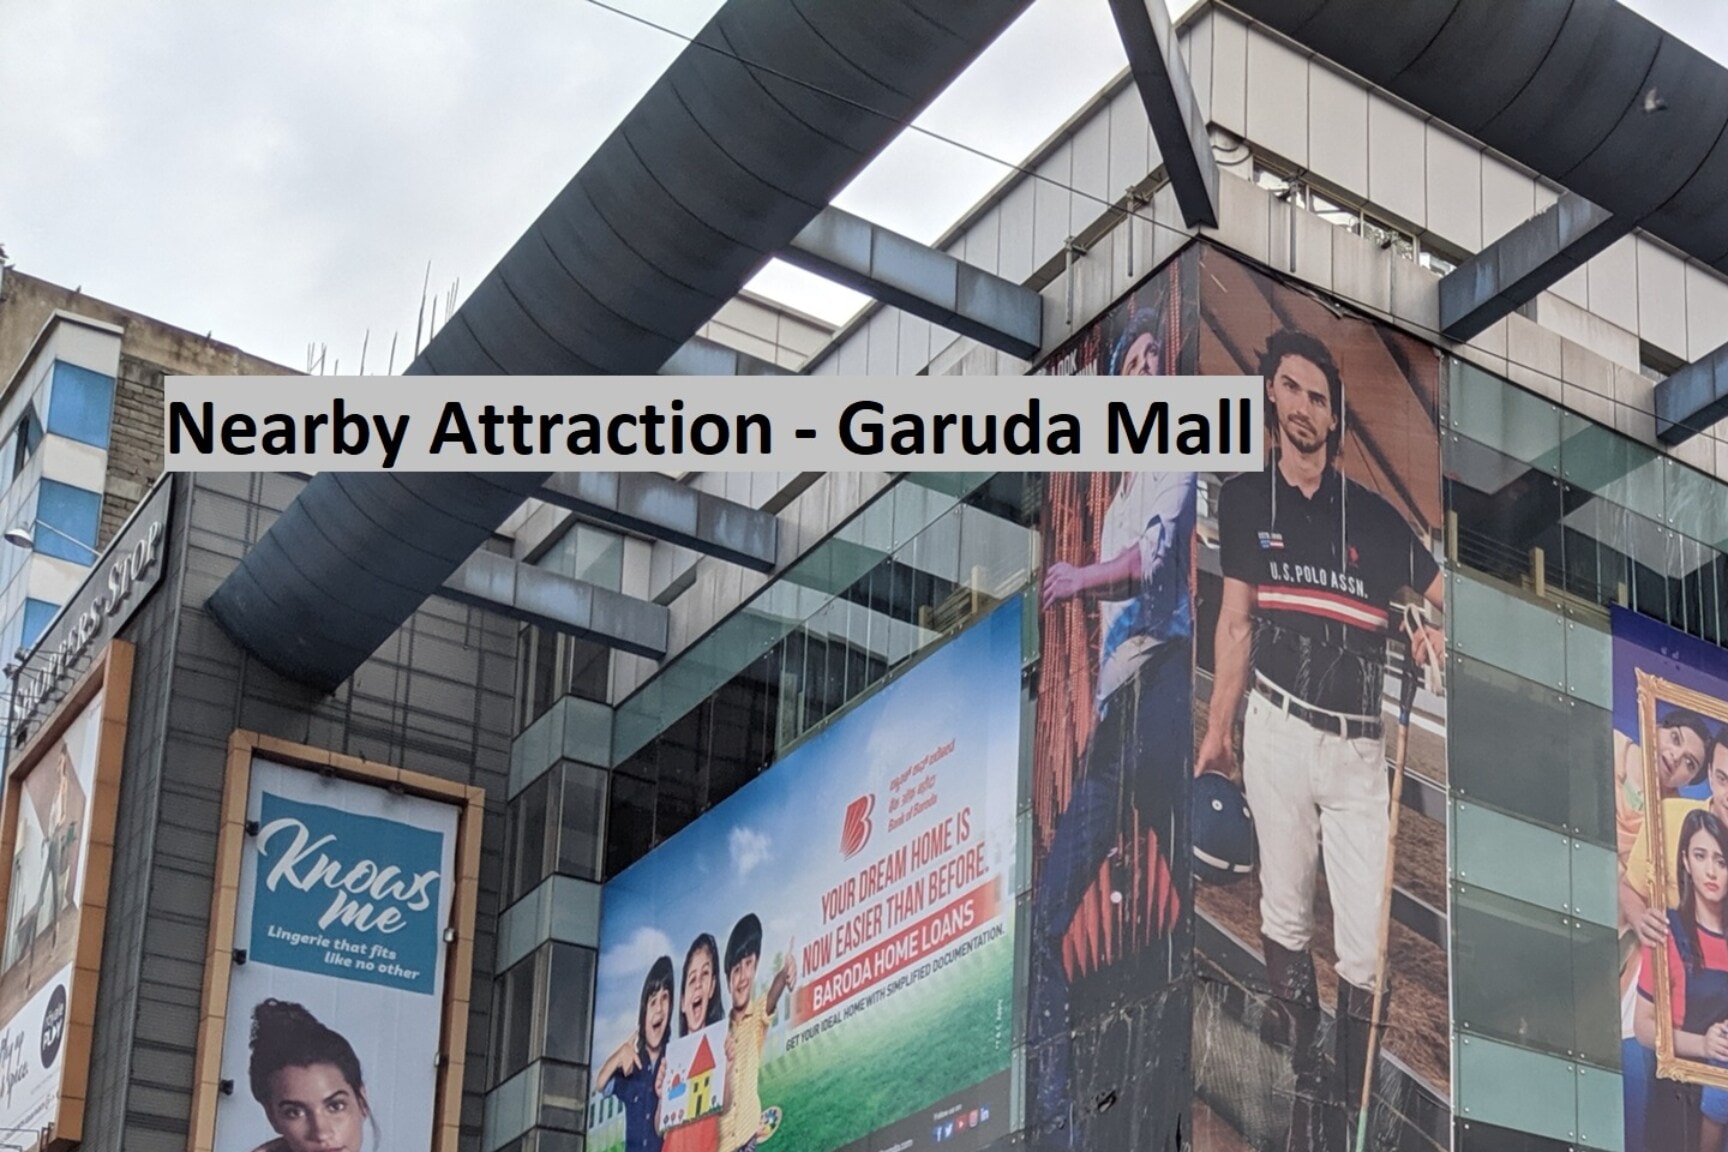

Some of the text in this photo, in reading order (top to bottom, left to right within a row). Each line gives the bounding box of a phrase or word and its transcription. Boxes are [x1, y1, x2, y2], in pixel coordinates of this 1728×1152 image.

[106, 521, 163, 617] STOP
[1270, 561, 1368, 599] U.S. POLO ASSN.
[256, 818, 440, 911] Knows
[318, 889, 407, 933] me
[802, 842, 989, 978] NOW EASIER THAN BEFORE.
[822, 807, 971, 924] YOUR DREAM HOME IS
[268, 925, 396, 960] Lingerie that fits
[324, 952, 420, 979] like no other
[786, 922, 1005, 1051] GET YOUR IDEAL HOME WITH SIMPLIFIED DOCUMENTATION.
[813, 900, 975, 1012] BARODA HOME LOANS
